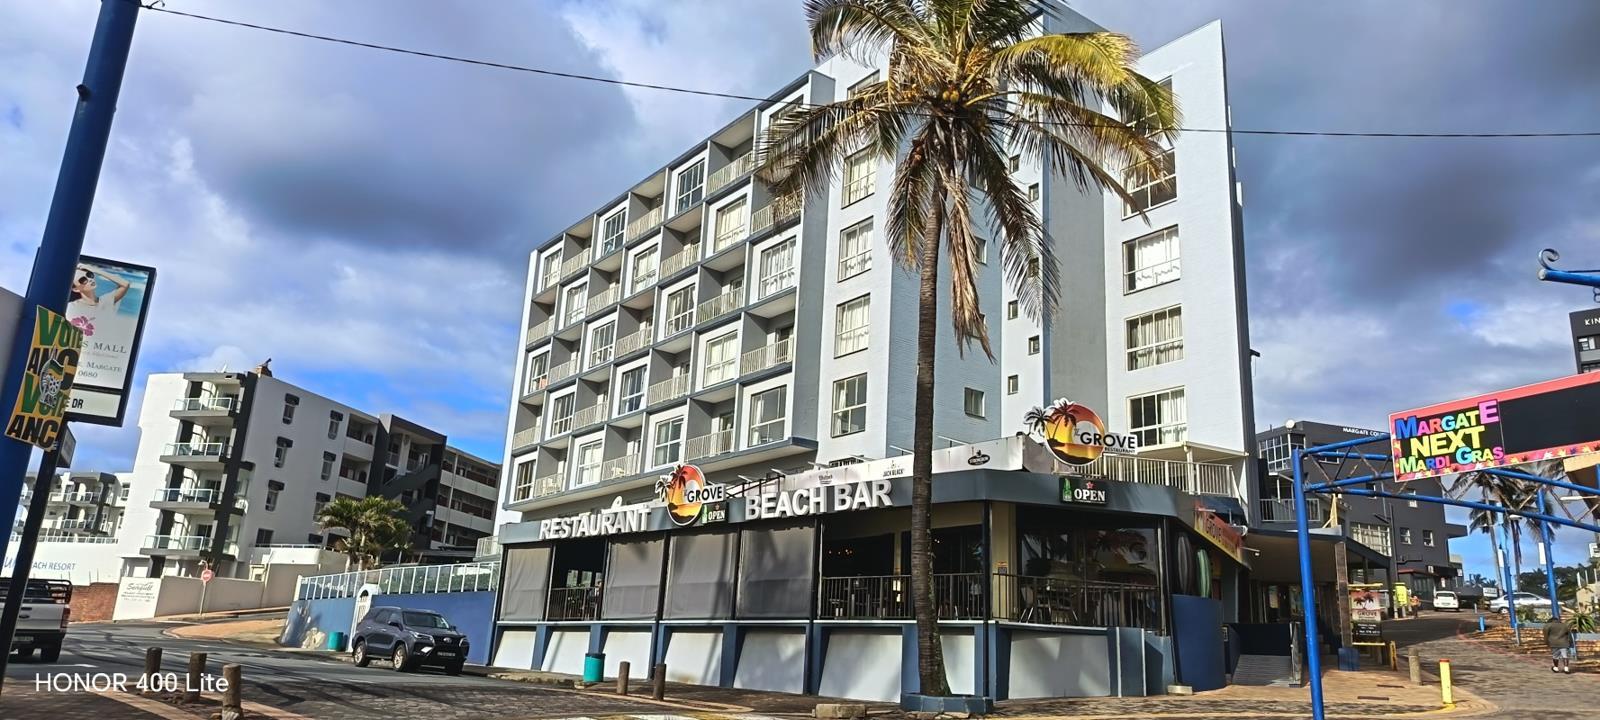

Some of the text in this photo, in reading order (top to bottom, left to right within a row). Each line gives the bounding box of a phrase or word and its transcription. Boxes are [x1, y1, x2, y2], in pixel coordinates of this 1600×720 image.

[38, 306, 83, 348] VOTE
[93, 342, 127, 354] MALL
[86, 361, 123, 373] MARGATE
[71, 398, 84, 410] DR
[1395, 399, 1499, 439] MARGATE
[7, 415, 58, 449] ANC
[1080, 432, 1135, 449] GROVE
[1410, 425, 1485, 458] NEXT
[1400, 446, 1504, 474] MARDI GRAS
[687, 486, 723, 503] GROVE
[745, 479, 893, 520] BEACH BAR
[1073, 488, 1106, 501] OPEN
[708, 509, 726, 520] OPEN
[539, 509, 651, 540] RESTAURANT
[48, 562, 76, 571] RESORT
